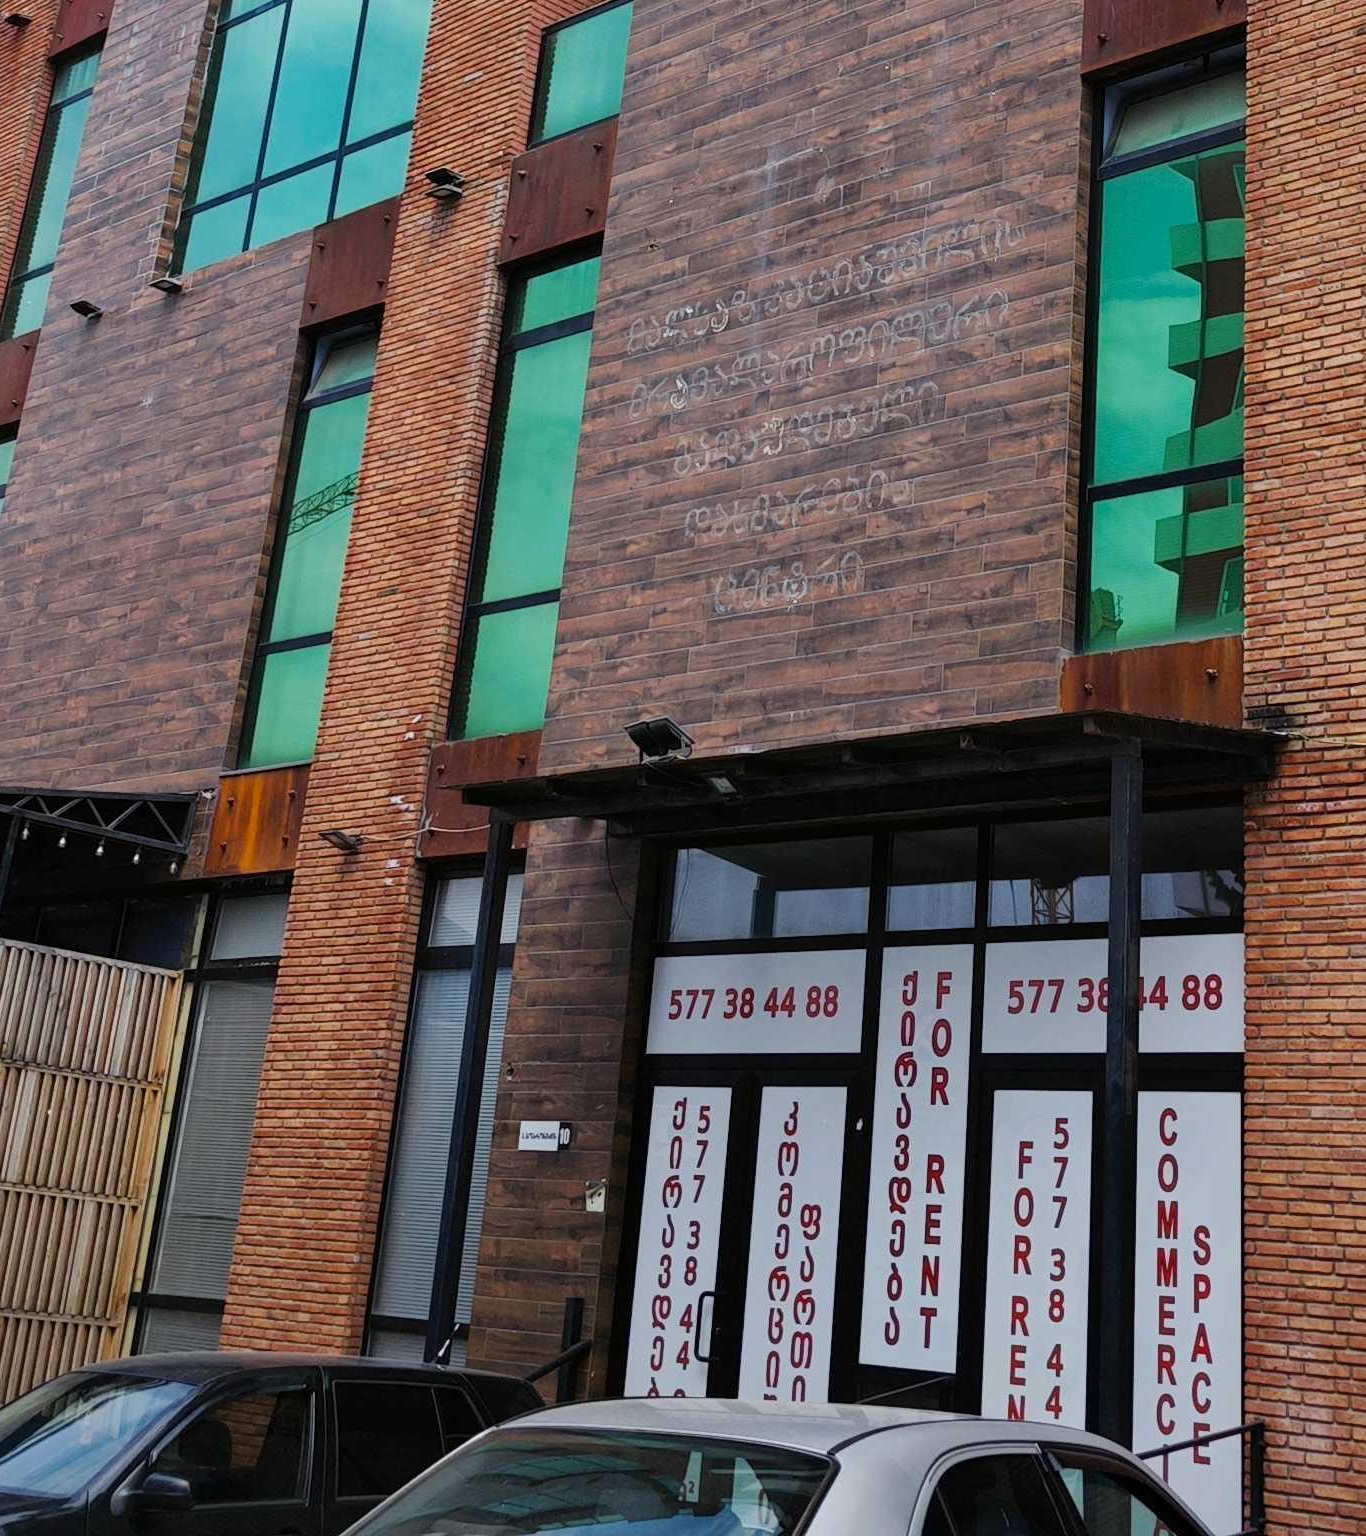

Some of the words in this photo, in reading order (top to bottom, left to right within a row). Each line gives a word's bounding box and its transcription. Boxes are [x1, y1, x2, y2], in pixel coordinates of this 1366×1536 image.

[668, 988, 716, 1021] 577
[723, 987, 755, 1020] 38
[763, 986, 796, 1019] 44
[805, 985, 840, 1018] 88
[930, 971, 953, 1106] FOR
[1007, 978, 1065, 1015] 577
[1181, 973, 1223, 1012] 88
[559, 1127, 571, 1145] 10
[692, 1105, 712, 1204] 577
[884, 970, 919, 1346] ქირავდება
[1051, 1117, 1069, 1229] 577
[647, 1097, 688, 1398] ქირავდებ
[683, 1220, 701, 1286] 38
[763, 1101, 800, 1401] კომერცი
[919, 1153, 946, 1349] RENT
[1013, 1141, 1034, 1276] FOR
[675, 1303, 693, 1371] 44
[1048, 1248, 1066, 1323] 38
[1156, 1107, 1179, 1484] COMMERCI
[1191, 1224, 1213, 1466] SPACE
[1007, 1295, 1030, 1421] REN
[1045, 1343, 1064, 1420] 44
